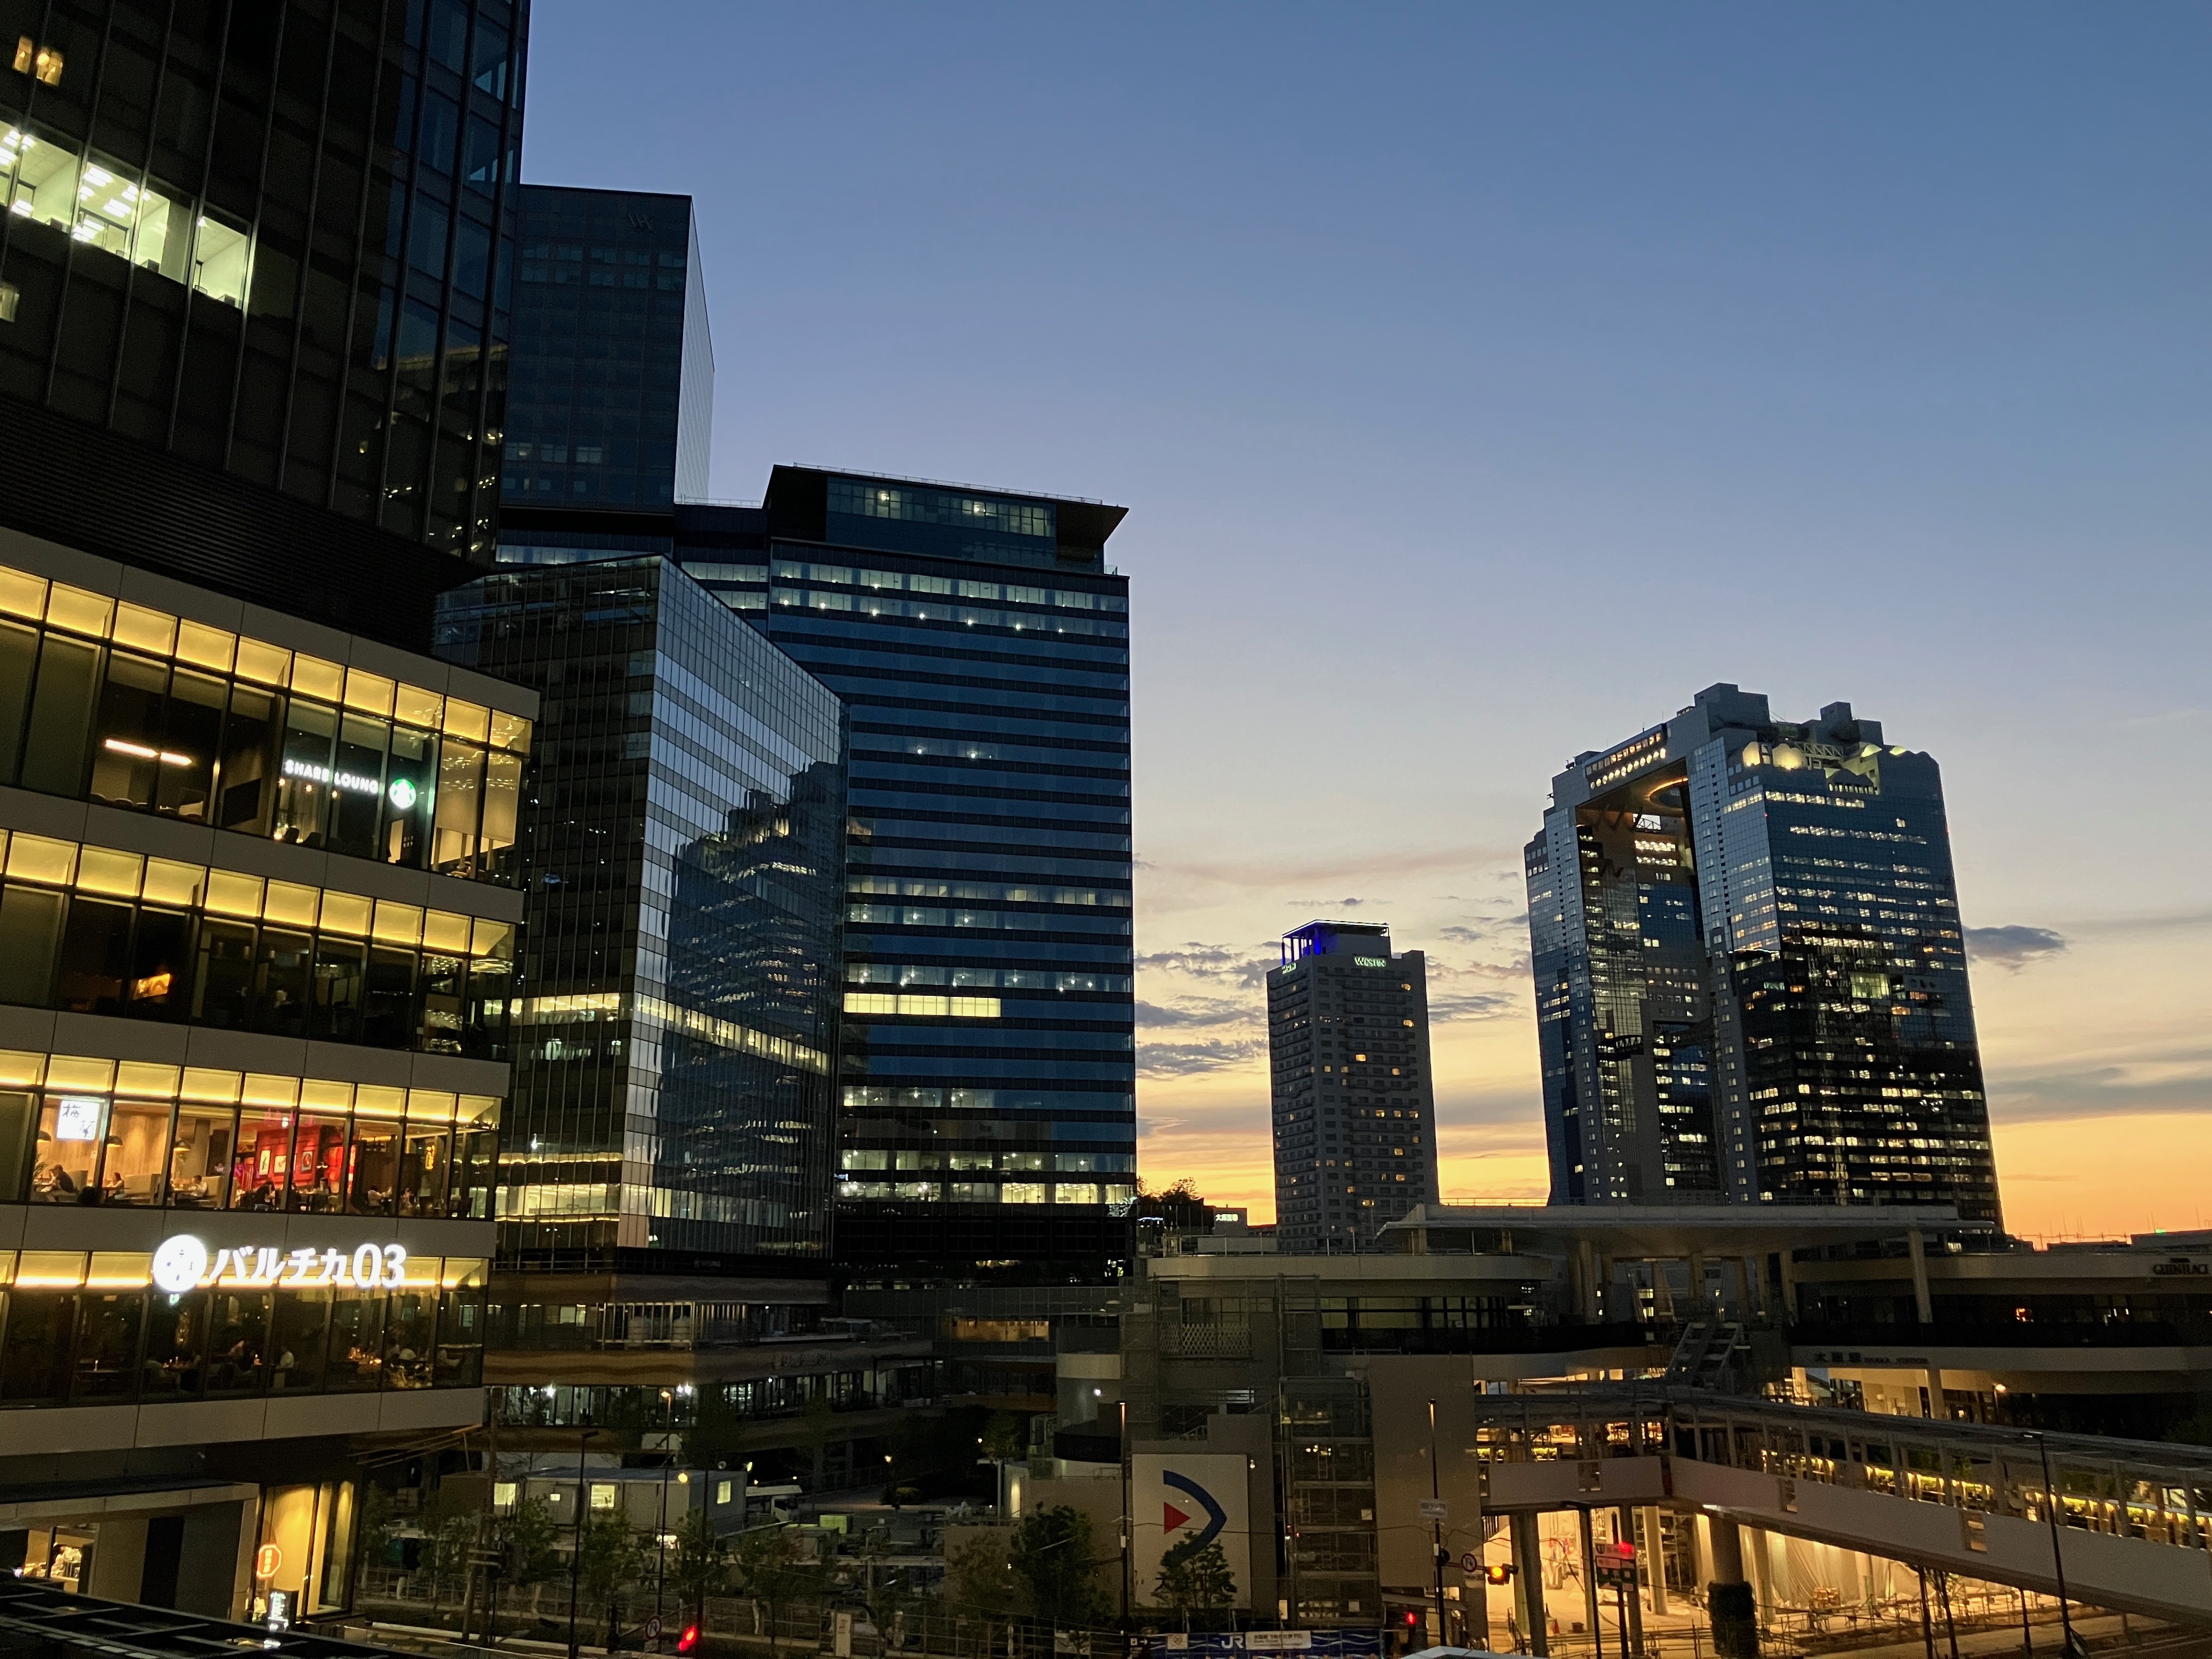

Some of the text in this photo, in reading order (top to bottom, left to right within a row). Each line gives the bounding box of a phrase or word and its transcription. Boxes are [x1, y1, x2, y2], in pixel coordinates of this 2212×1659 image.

[285, 759, 379, 794] SHARE LOUNG
[208, 1243, 407, 1288] バルチカ03
[1221, 1635, 1244, 1649] JR
